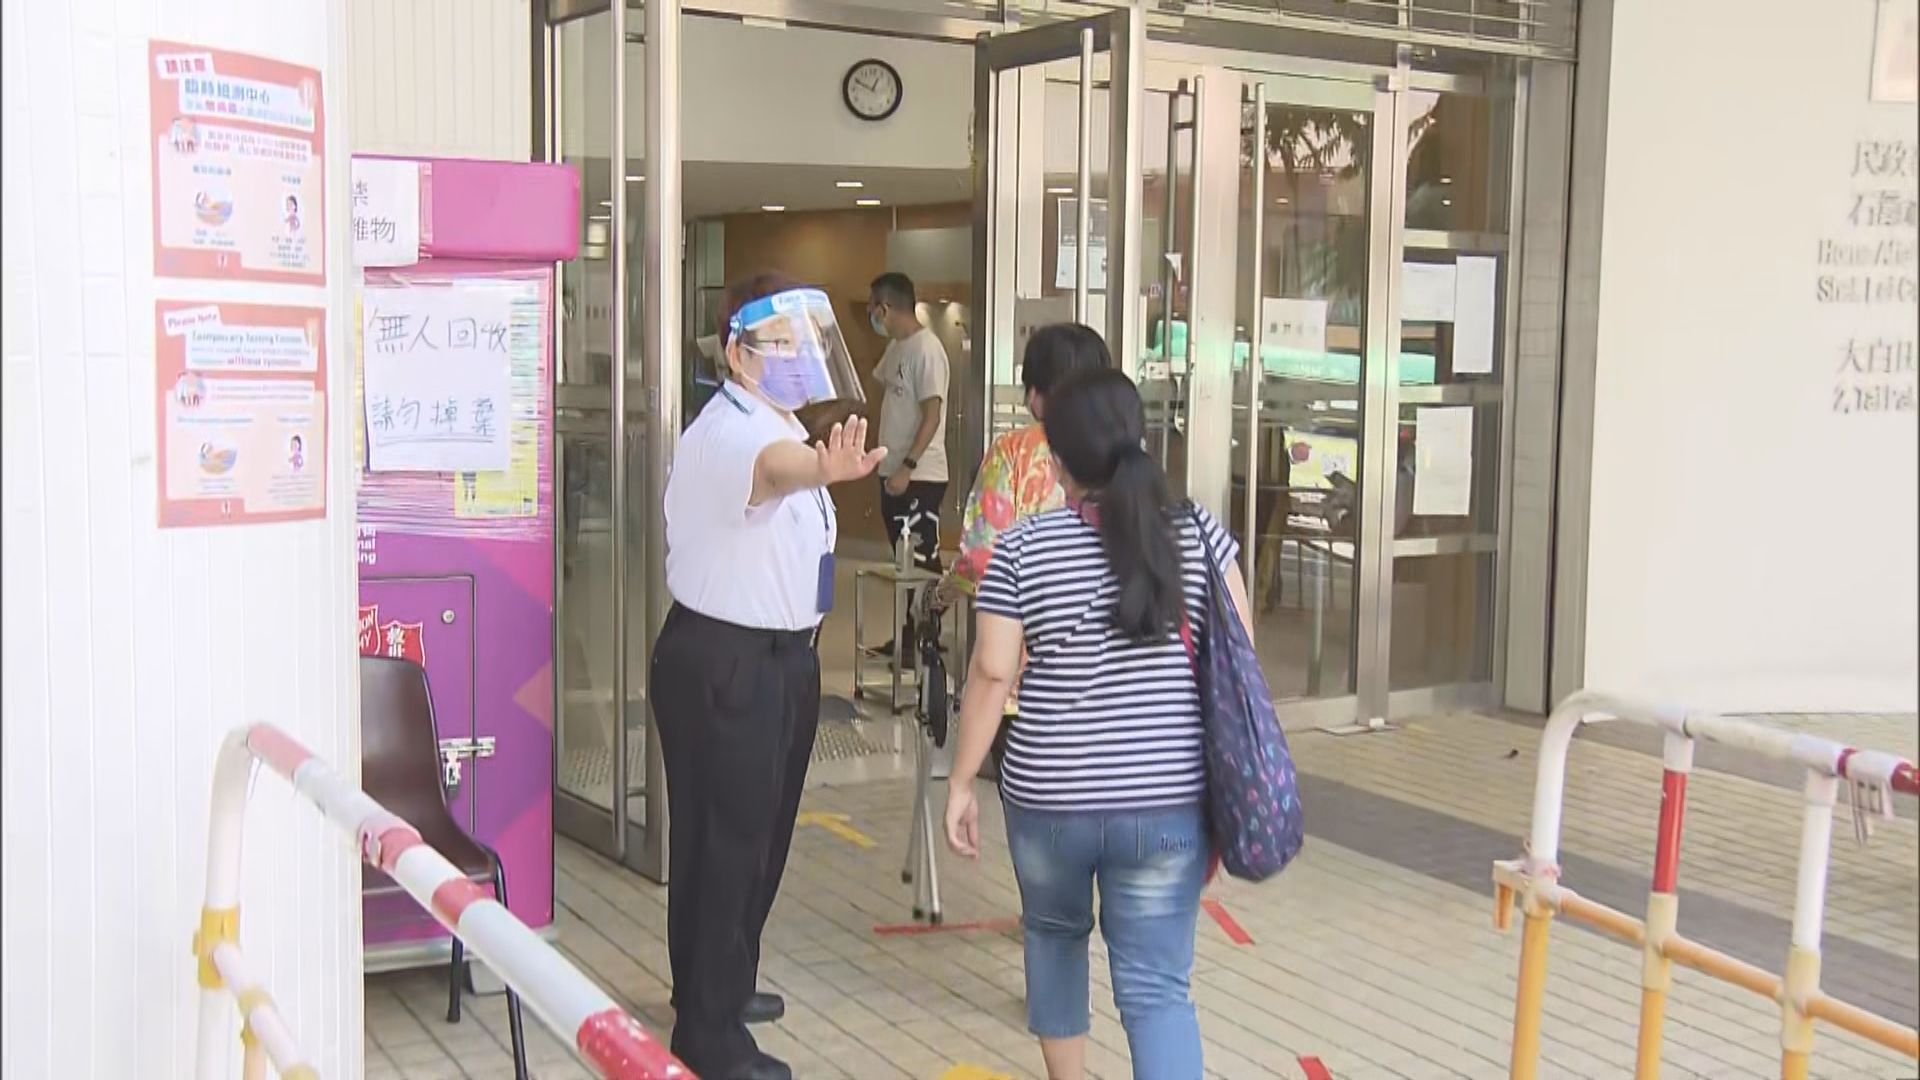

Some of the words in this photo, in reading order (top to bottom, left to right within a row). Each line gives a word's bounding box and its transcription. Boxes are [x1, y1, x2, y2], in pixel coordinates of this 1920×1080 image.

[1850, 139, 1917, 178] 民政
[368, 307, 508, 354] 無人回收
